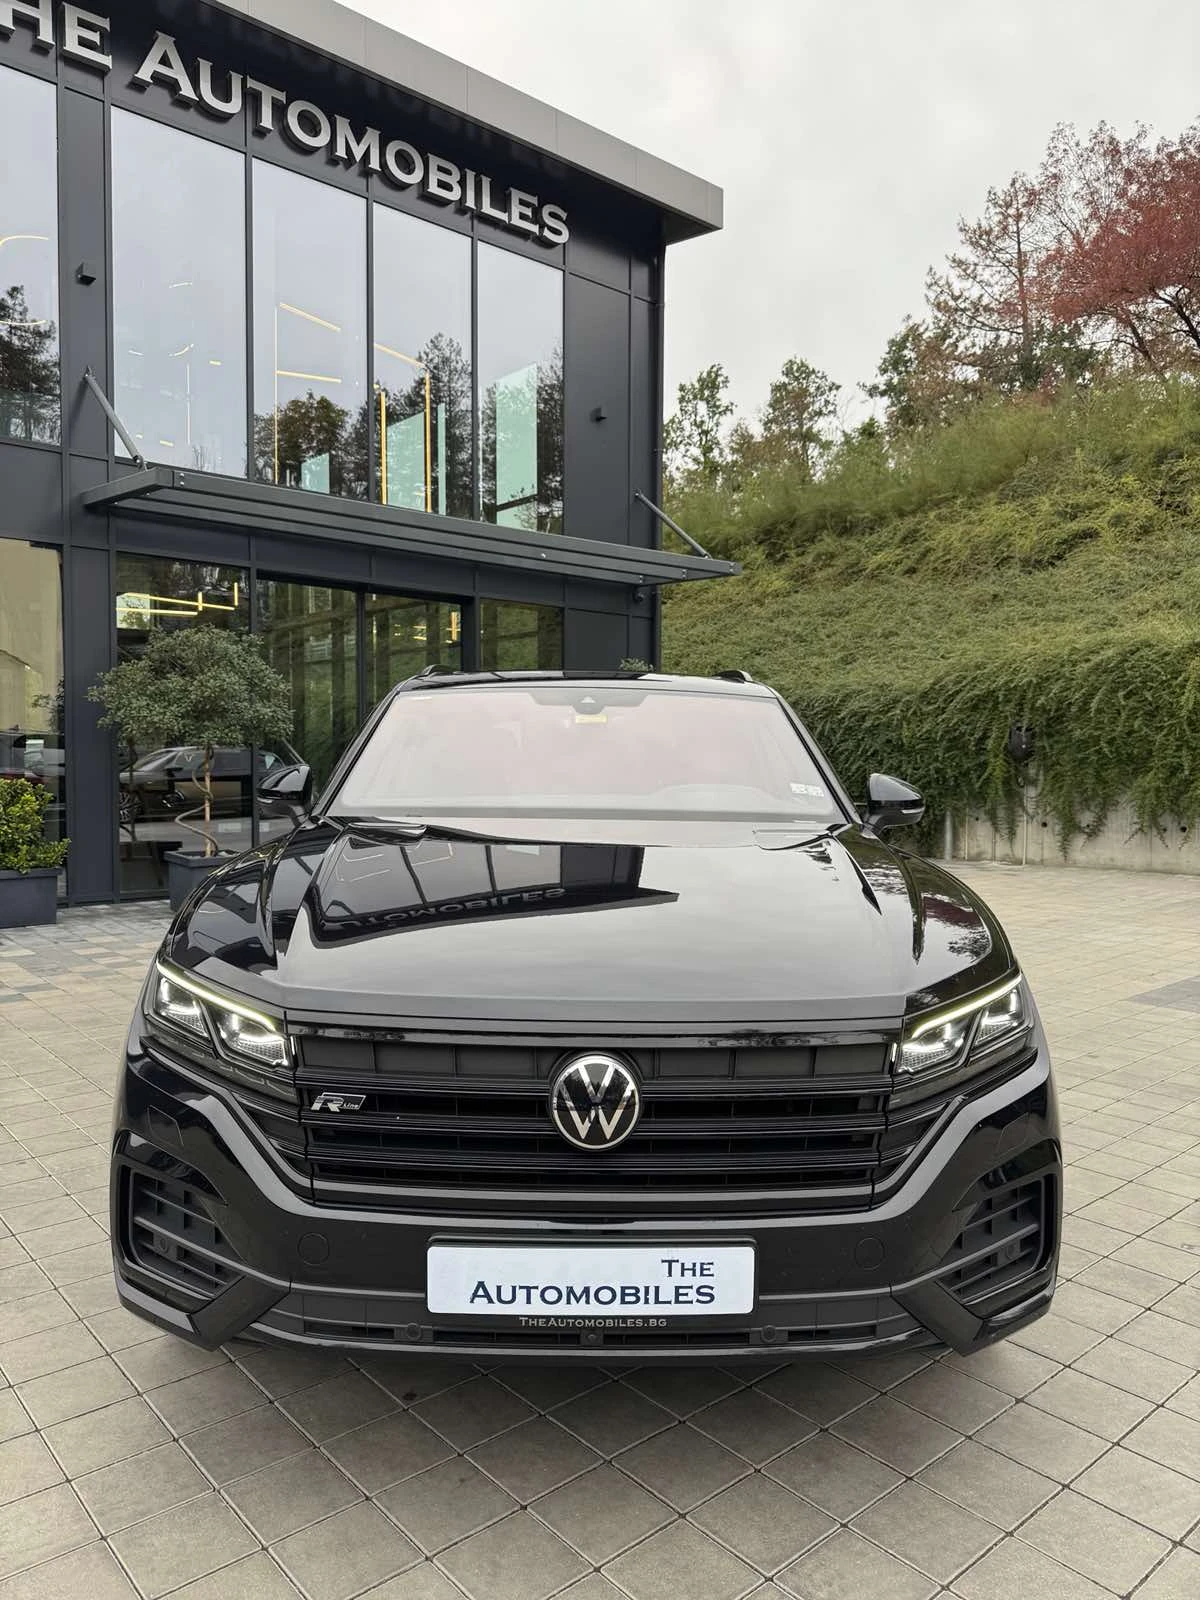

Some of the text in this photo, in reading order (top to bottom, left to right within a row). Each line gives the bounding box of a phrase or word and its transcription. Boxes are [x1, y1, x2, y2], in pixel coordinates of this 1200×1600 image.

[133, 31, 570, 245] AUTOMOBILES
[661, 1259, 715, 1277] THE
[469, 1281, 715, 1305] AUTOMOBILES
